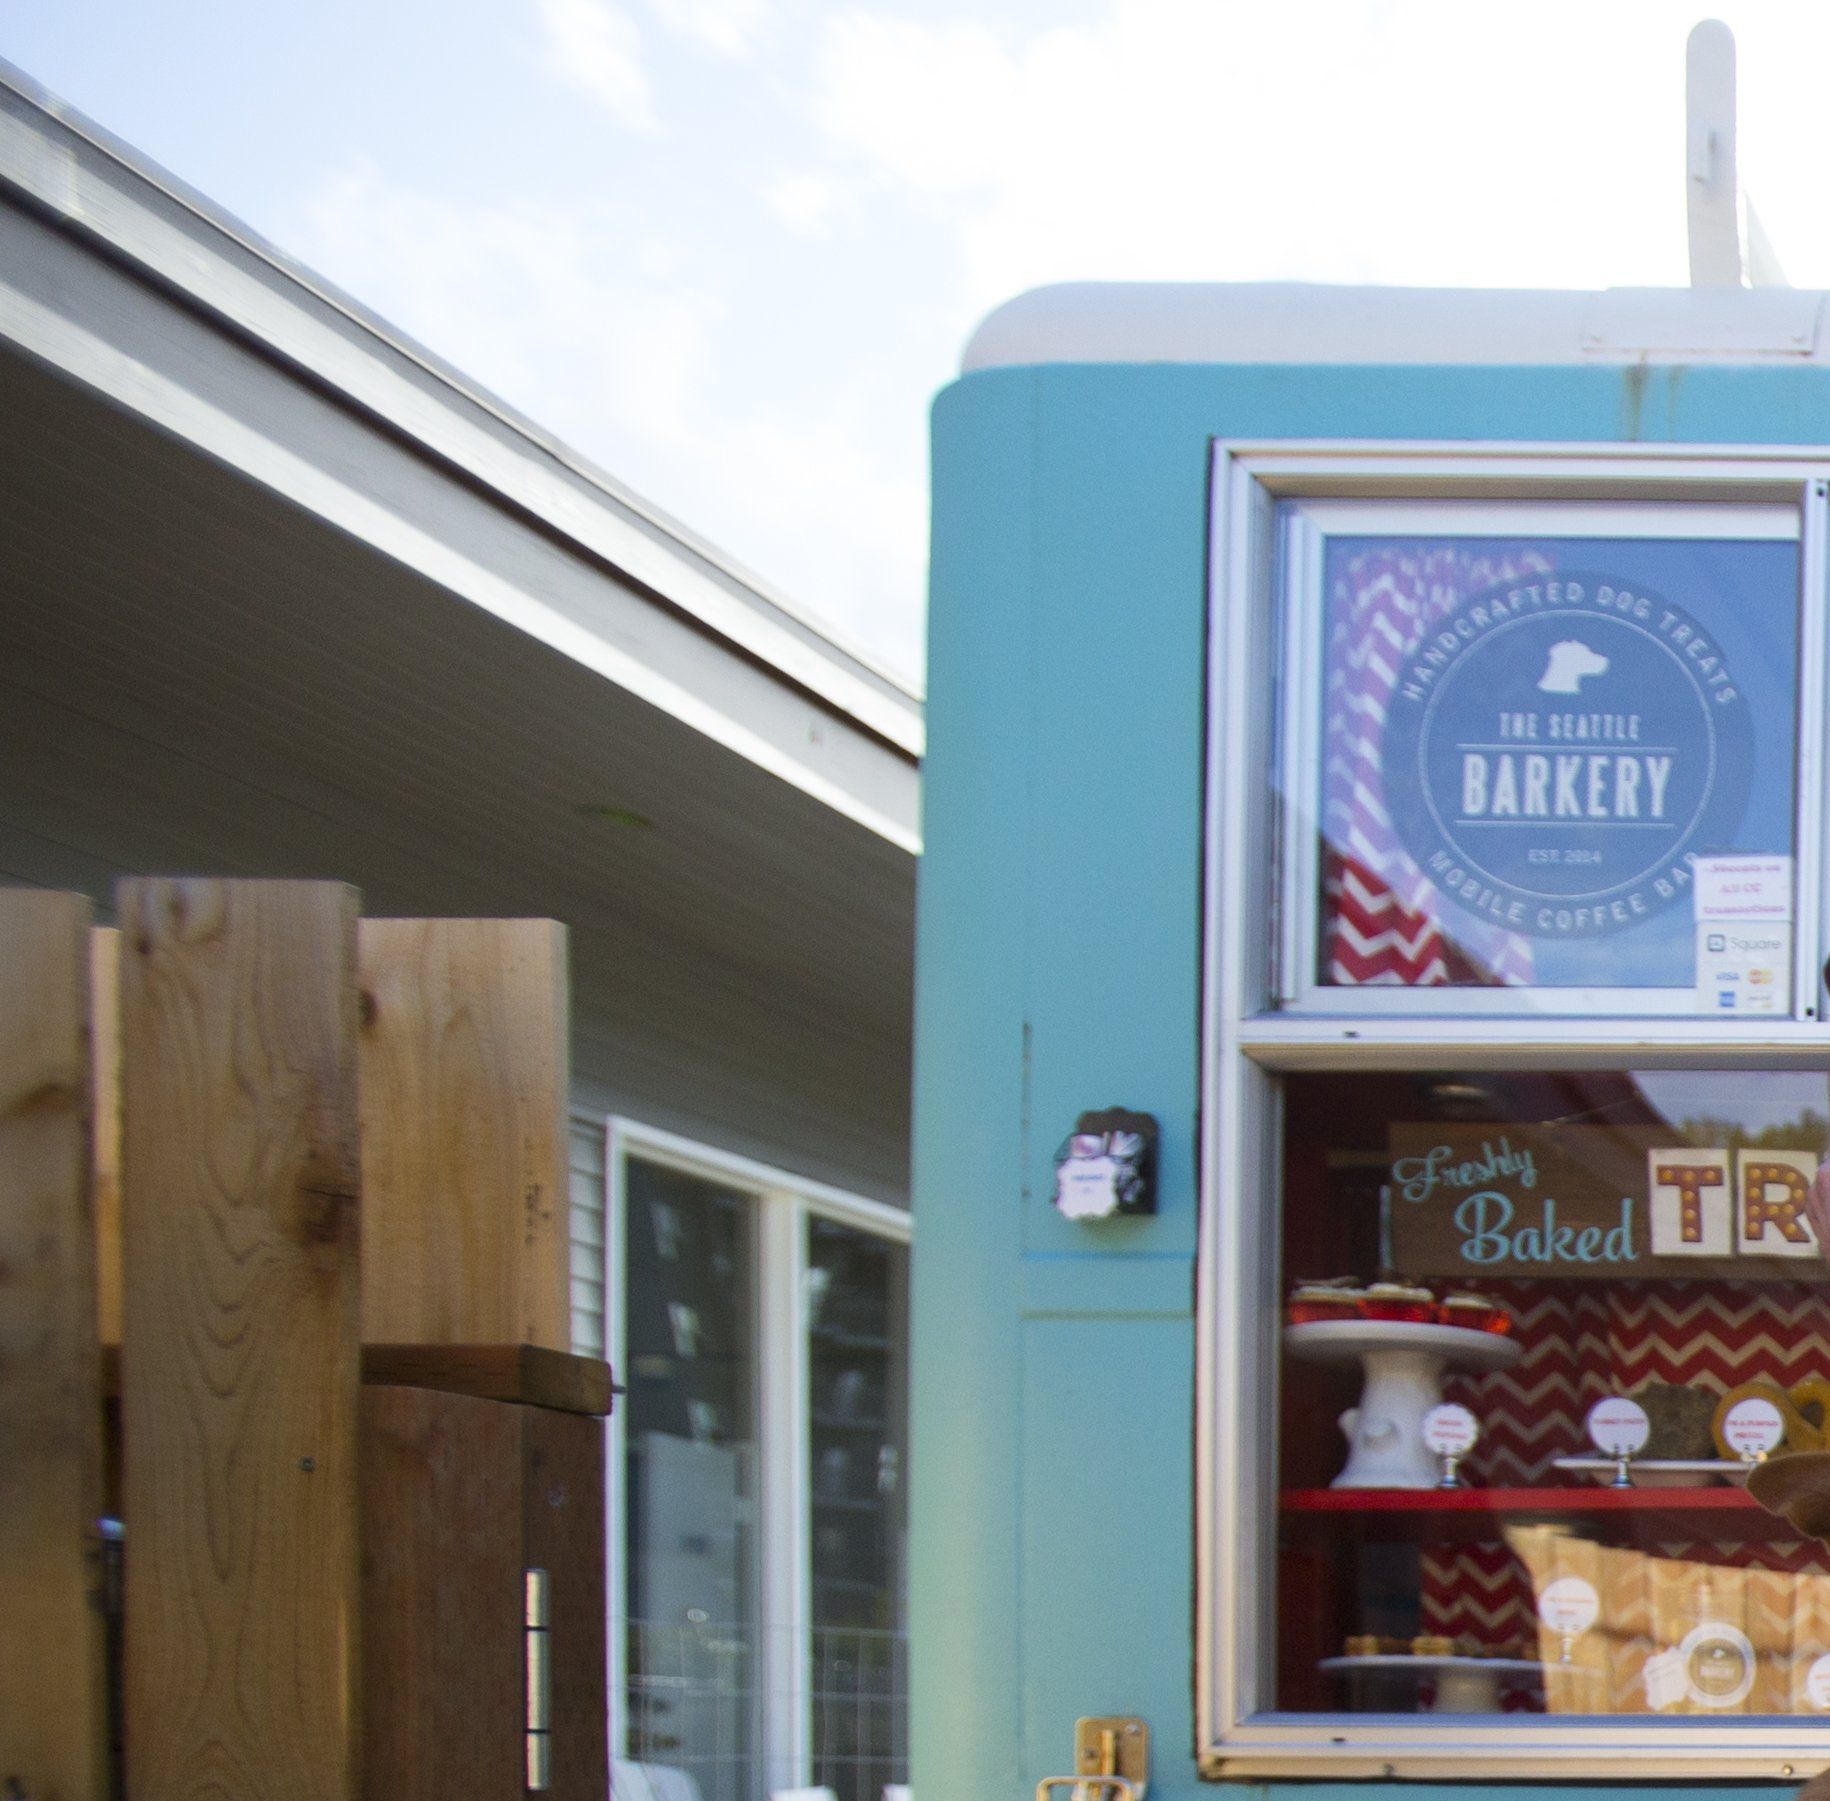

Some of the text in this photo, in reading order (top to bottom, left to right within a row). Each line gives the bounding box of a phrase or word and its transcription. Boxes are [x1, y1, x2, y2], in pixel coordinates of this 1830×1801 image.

[1402, 582, 1739, 705] HANDCRAFTED DOG TREATS
[1499, 712, 1642, 742] THE SEATTLE
[1461, 751, 1674, 819] BARKERY
[1427, 849, 1527, 923] MOBILE
[1536, 892, 1648, 931] COFFEE
[1730, 936, 1782, 953] Square
[1391, 1135, 1539, 1204] Freshly
[1453, 1190, 1639, 1265] Baked
